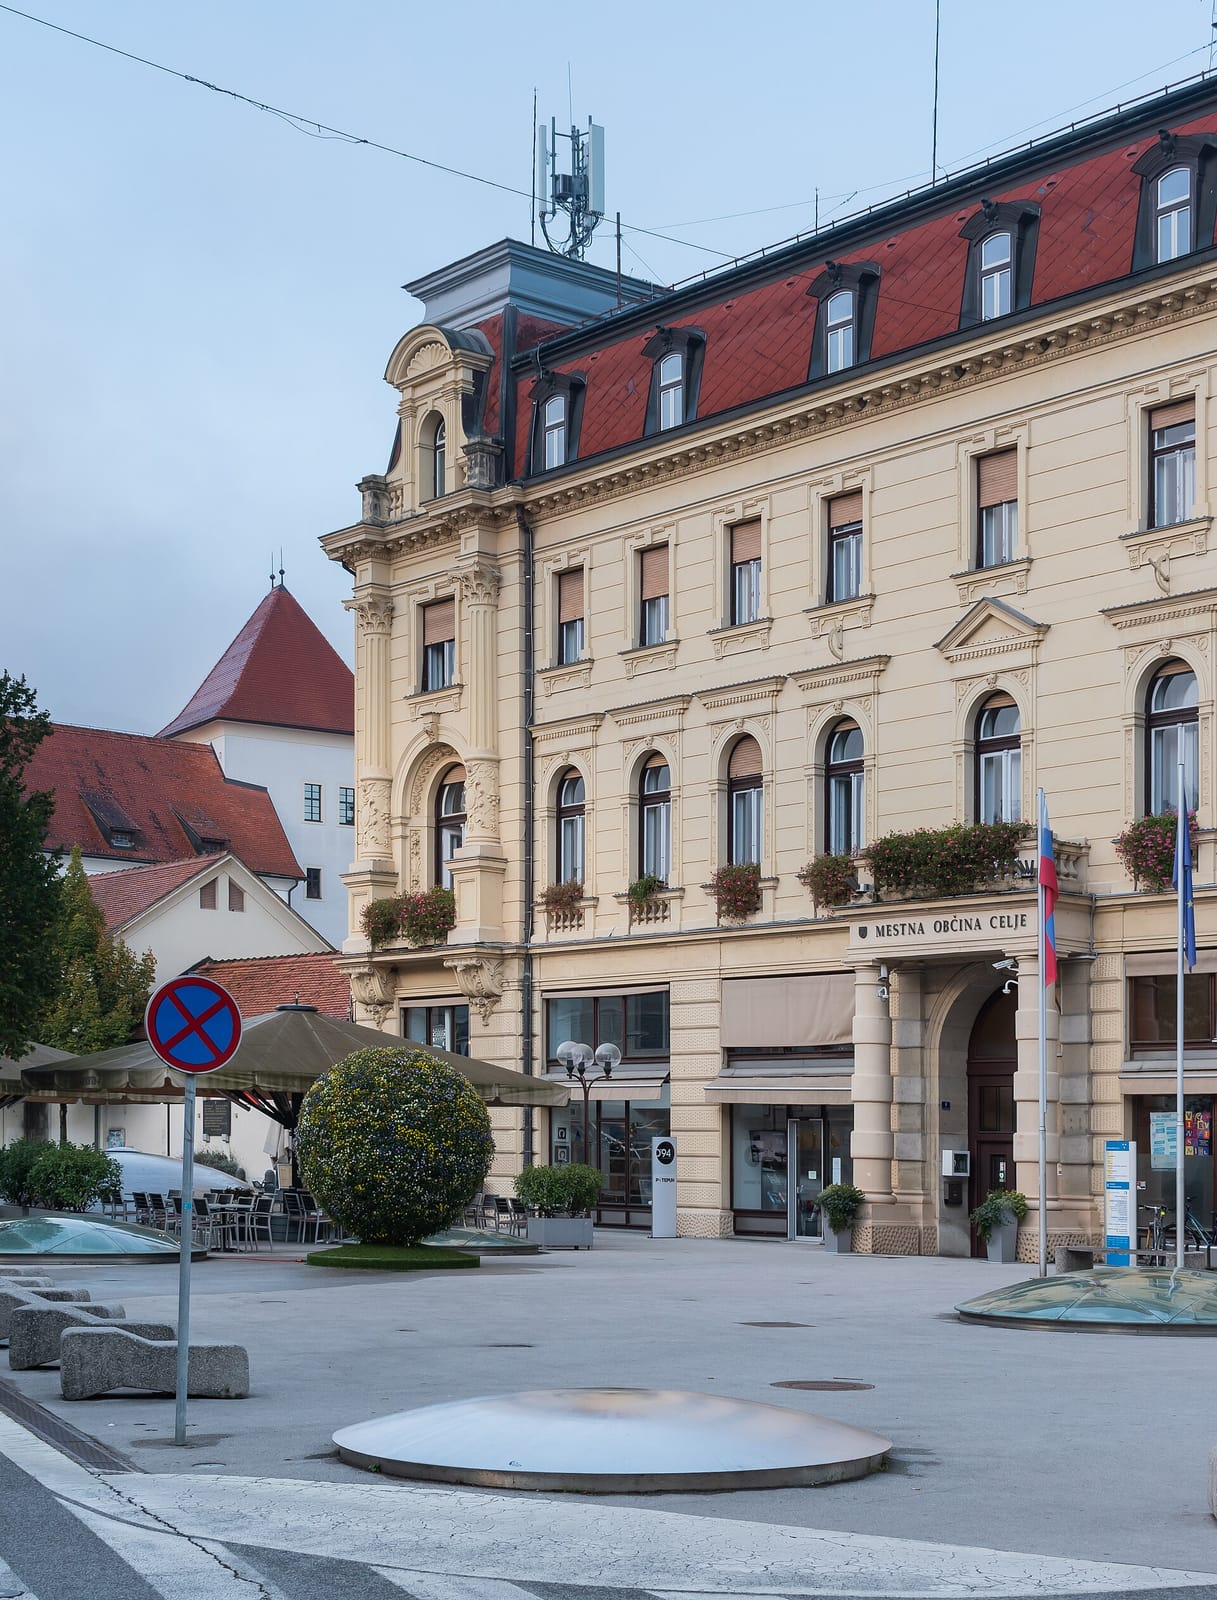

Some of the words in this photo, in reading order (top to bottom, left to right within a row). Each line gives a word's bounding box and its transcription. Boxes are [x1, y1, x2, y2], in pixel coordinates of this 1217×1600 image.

[875, 922, 925, 937] MESTNA
[933, 915, 982, 933] OBČINA
[990, 914, 1027, 930] CELJE
